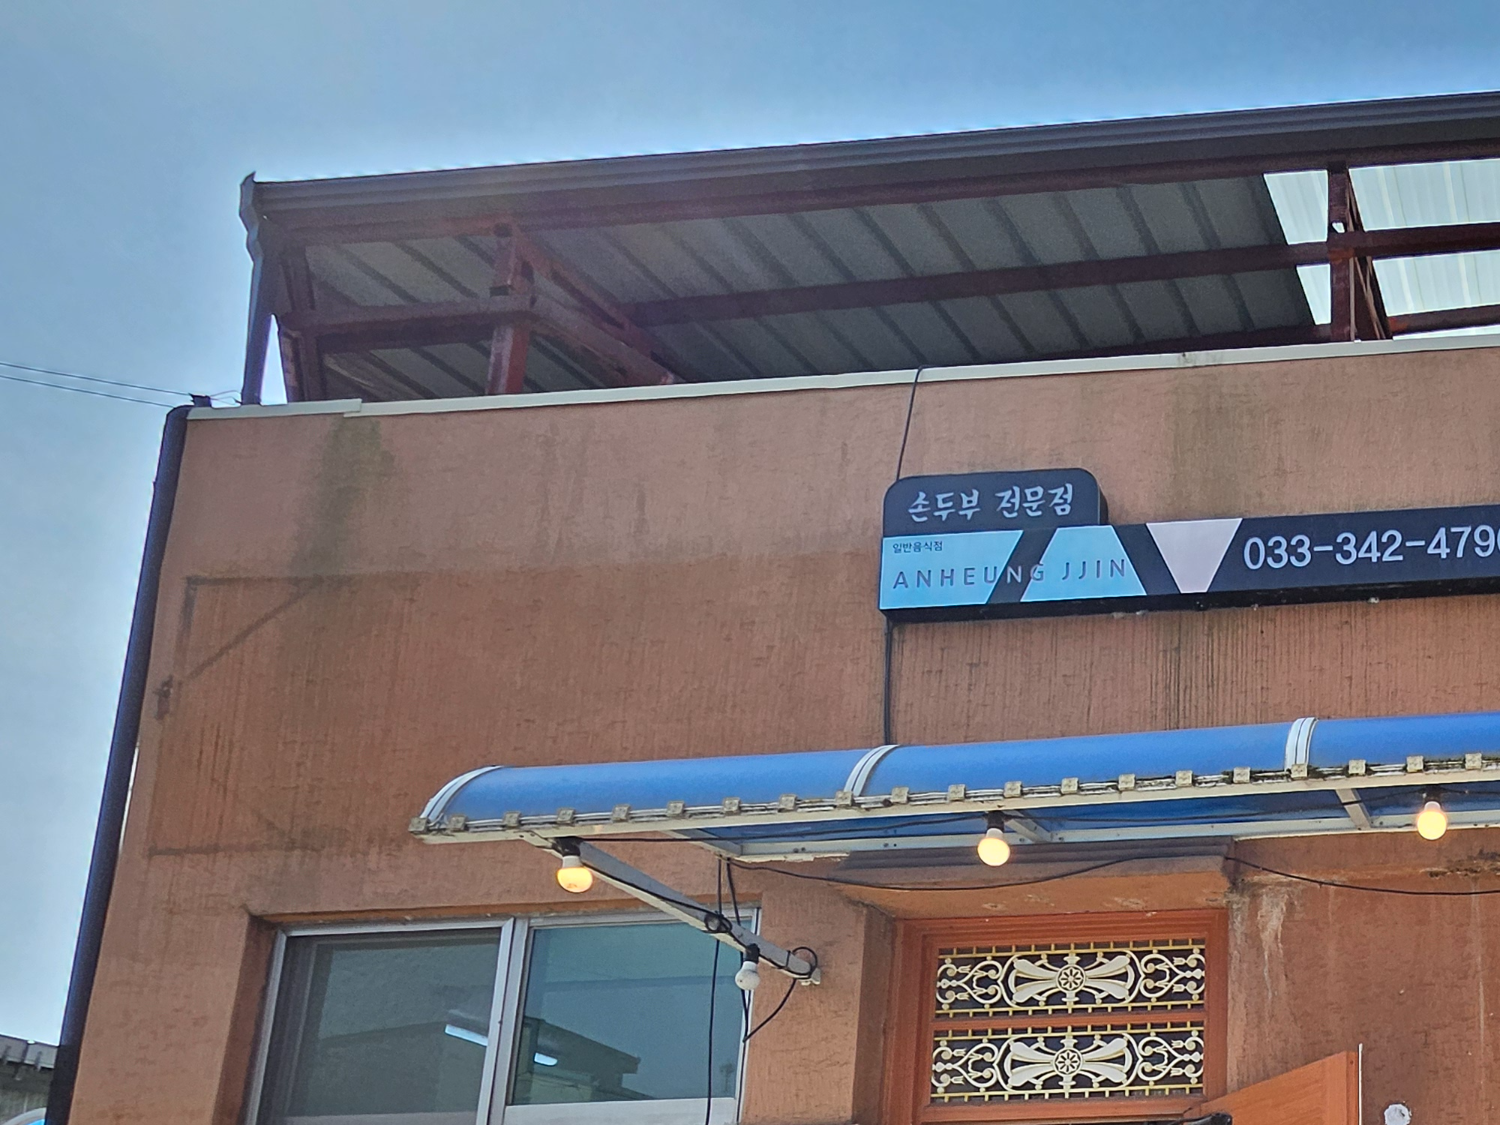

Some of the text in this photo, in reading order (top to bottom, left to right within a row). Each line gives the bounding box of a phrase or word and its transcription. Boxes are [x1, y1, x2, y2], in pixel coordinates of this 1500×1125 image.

[907, 483, 1074, 523] 손두부 전문점
[892, 541, 943, 555] 일반음식점
[892, 558, 1126, 590] ANHEUNG JJIN
